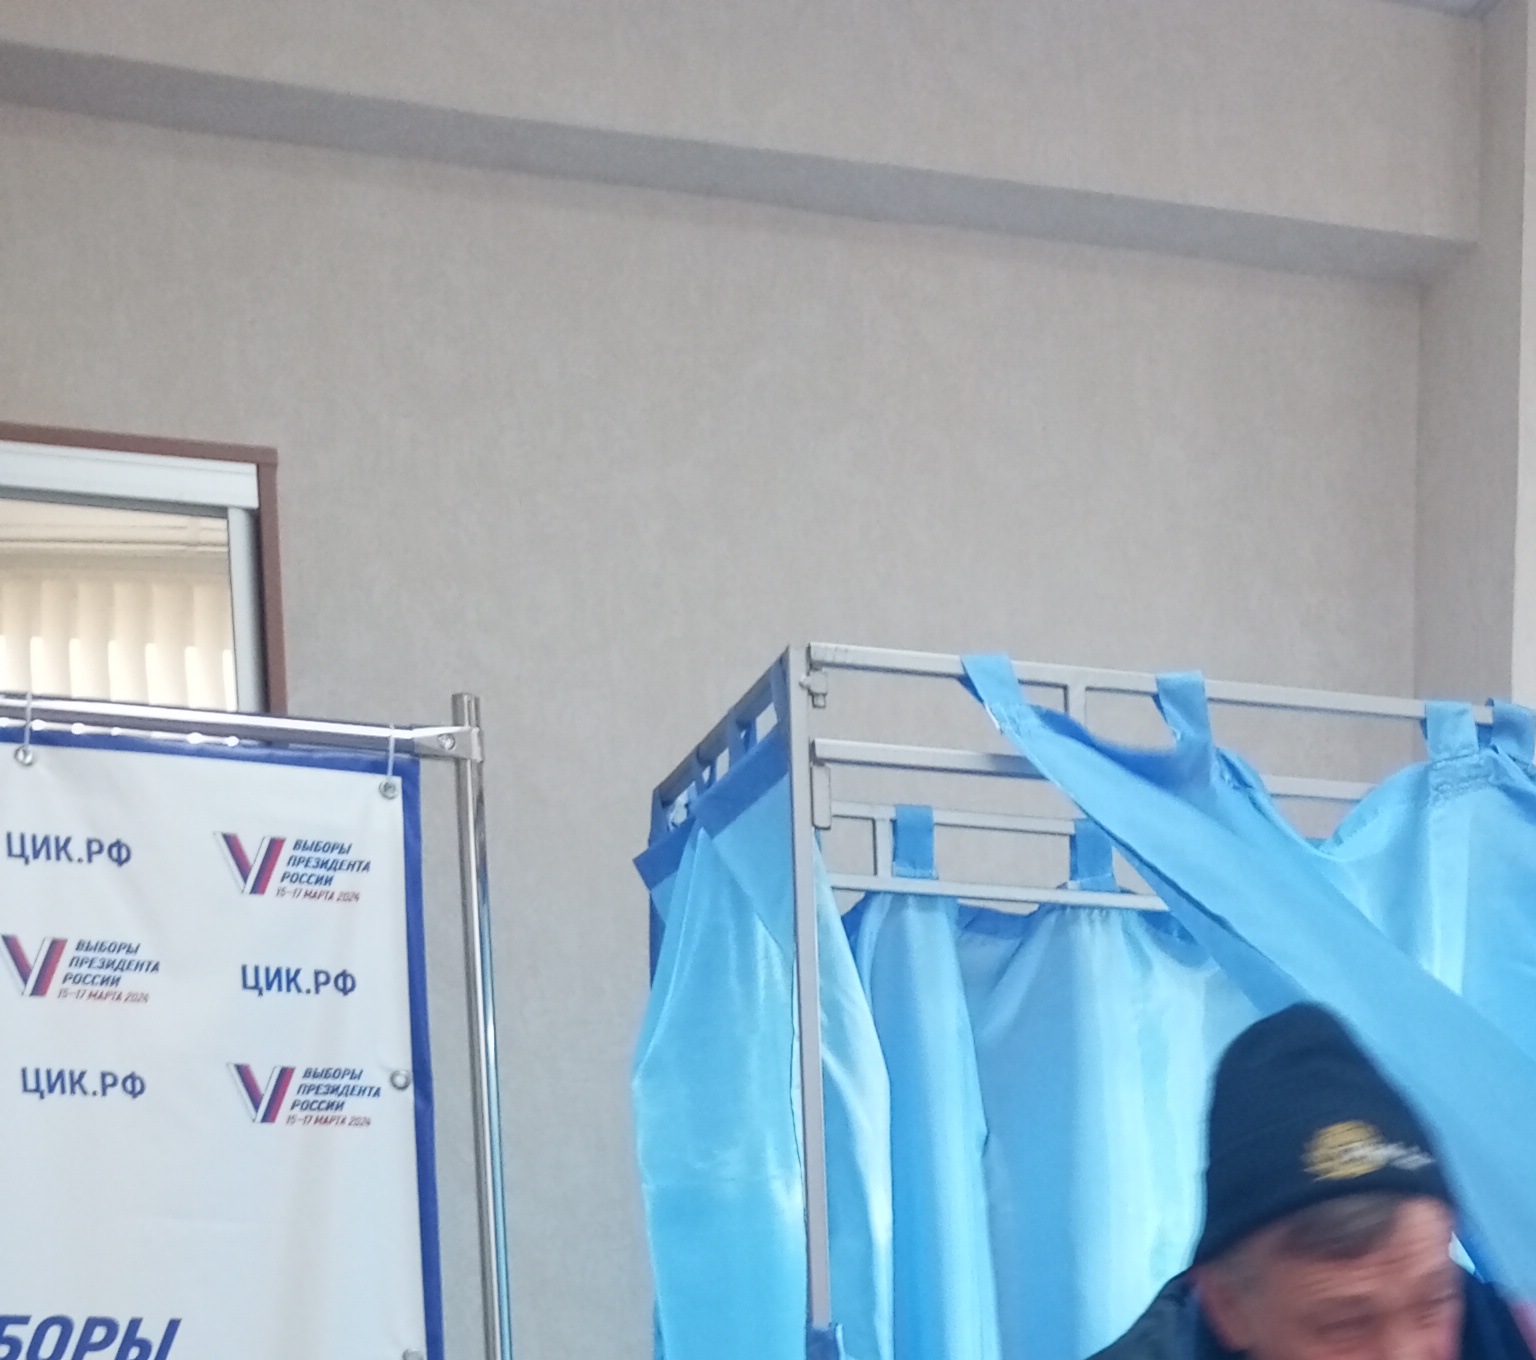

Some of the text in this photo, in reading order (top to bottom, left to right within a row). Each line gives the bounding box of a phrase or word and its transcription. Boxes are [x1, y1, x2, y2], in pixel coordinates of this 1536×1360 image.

[5, 831, 132, 868] ЦИК.РФ
[293, 840, 353, 855] ВЫБОРЫ
[287, 855, 371, 872] ПРЕЗИДЕНТА
[280, 871, 334, 886] РОССИИ
[75, 939, 141, 955] ВЫБОРЫ
[62, 972, 121, 987] РОССИИ
[241, 964, 357, 997] ЦИК.РФ
[302, 1067, 363, 1080] ВЫБОРЫ
[20, 1066, 146, 1100] ЦИК.РФ
[296, 1083, 381, 1097] ПРЕЗИДЕНТА
[290, 1099, 345, 1111] РОССИИ
